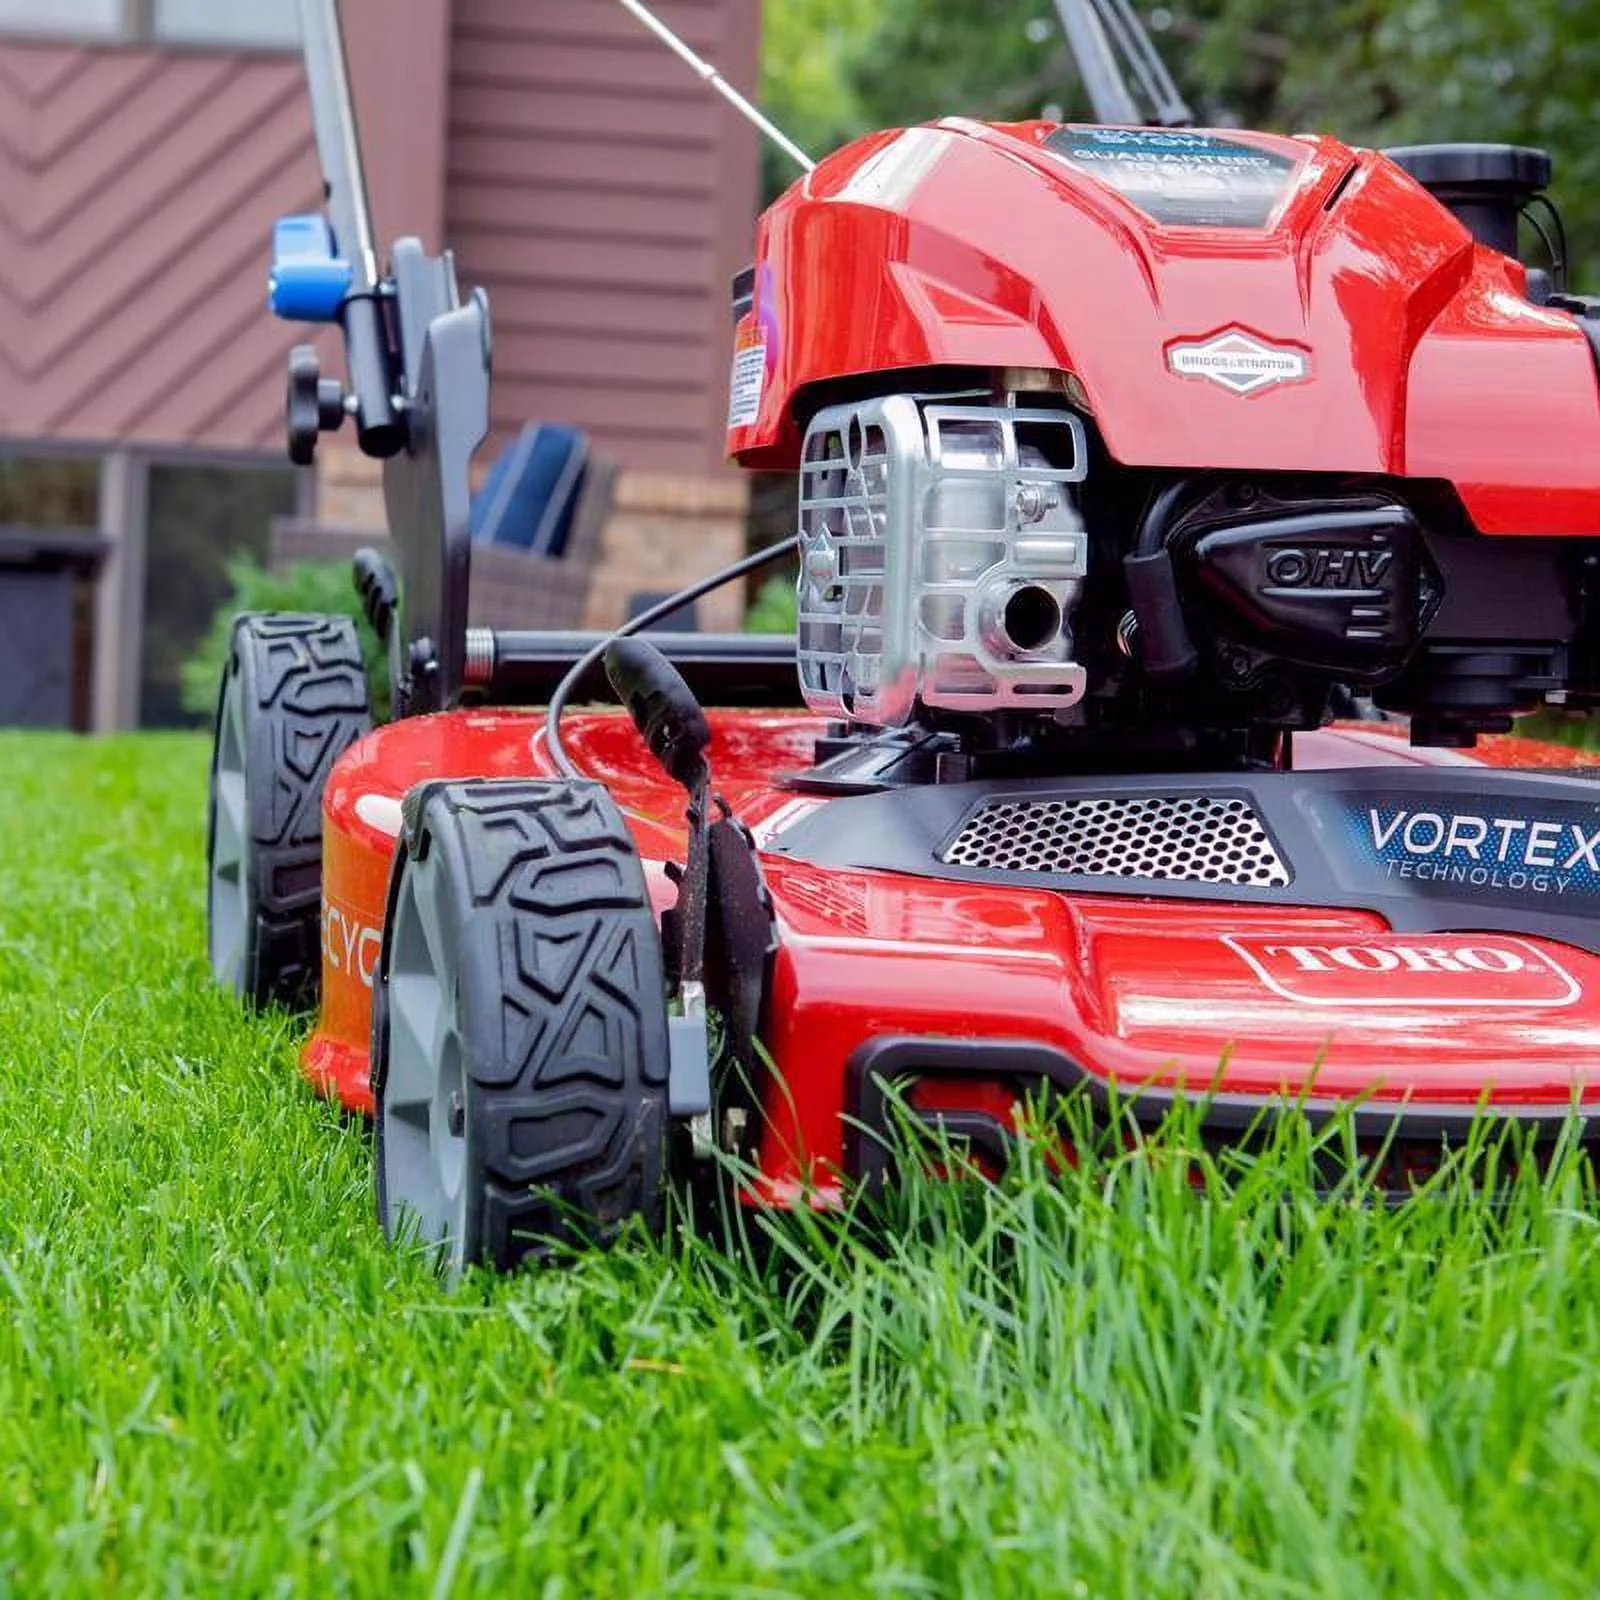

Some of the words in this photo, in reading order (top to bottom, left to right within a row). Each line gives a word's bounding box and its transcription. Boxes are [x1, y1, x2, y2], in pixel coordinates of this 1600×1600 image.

[1267, 549, 1393, 586] OHV
[1370, 808, 1600, 872] VORTEX
[1386, 859, 1571, 895] TECHNOLOGY
[1264, 945, 1524, 973] TORO
